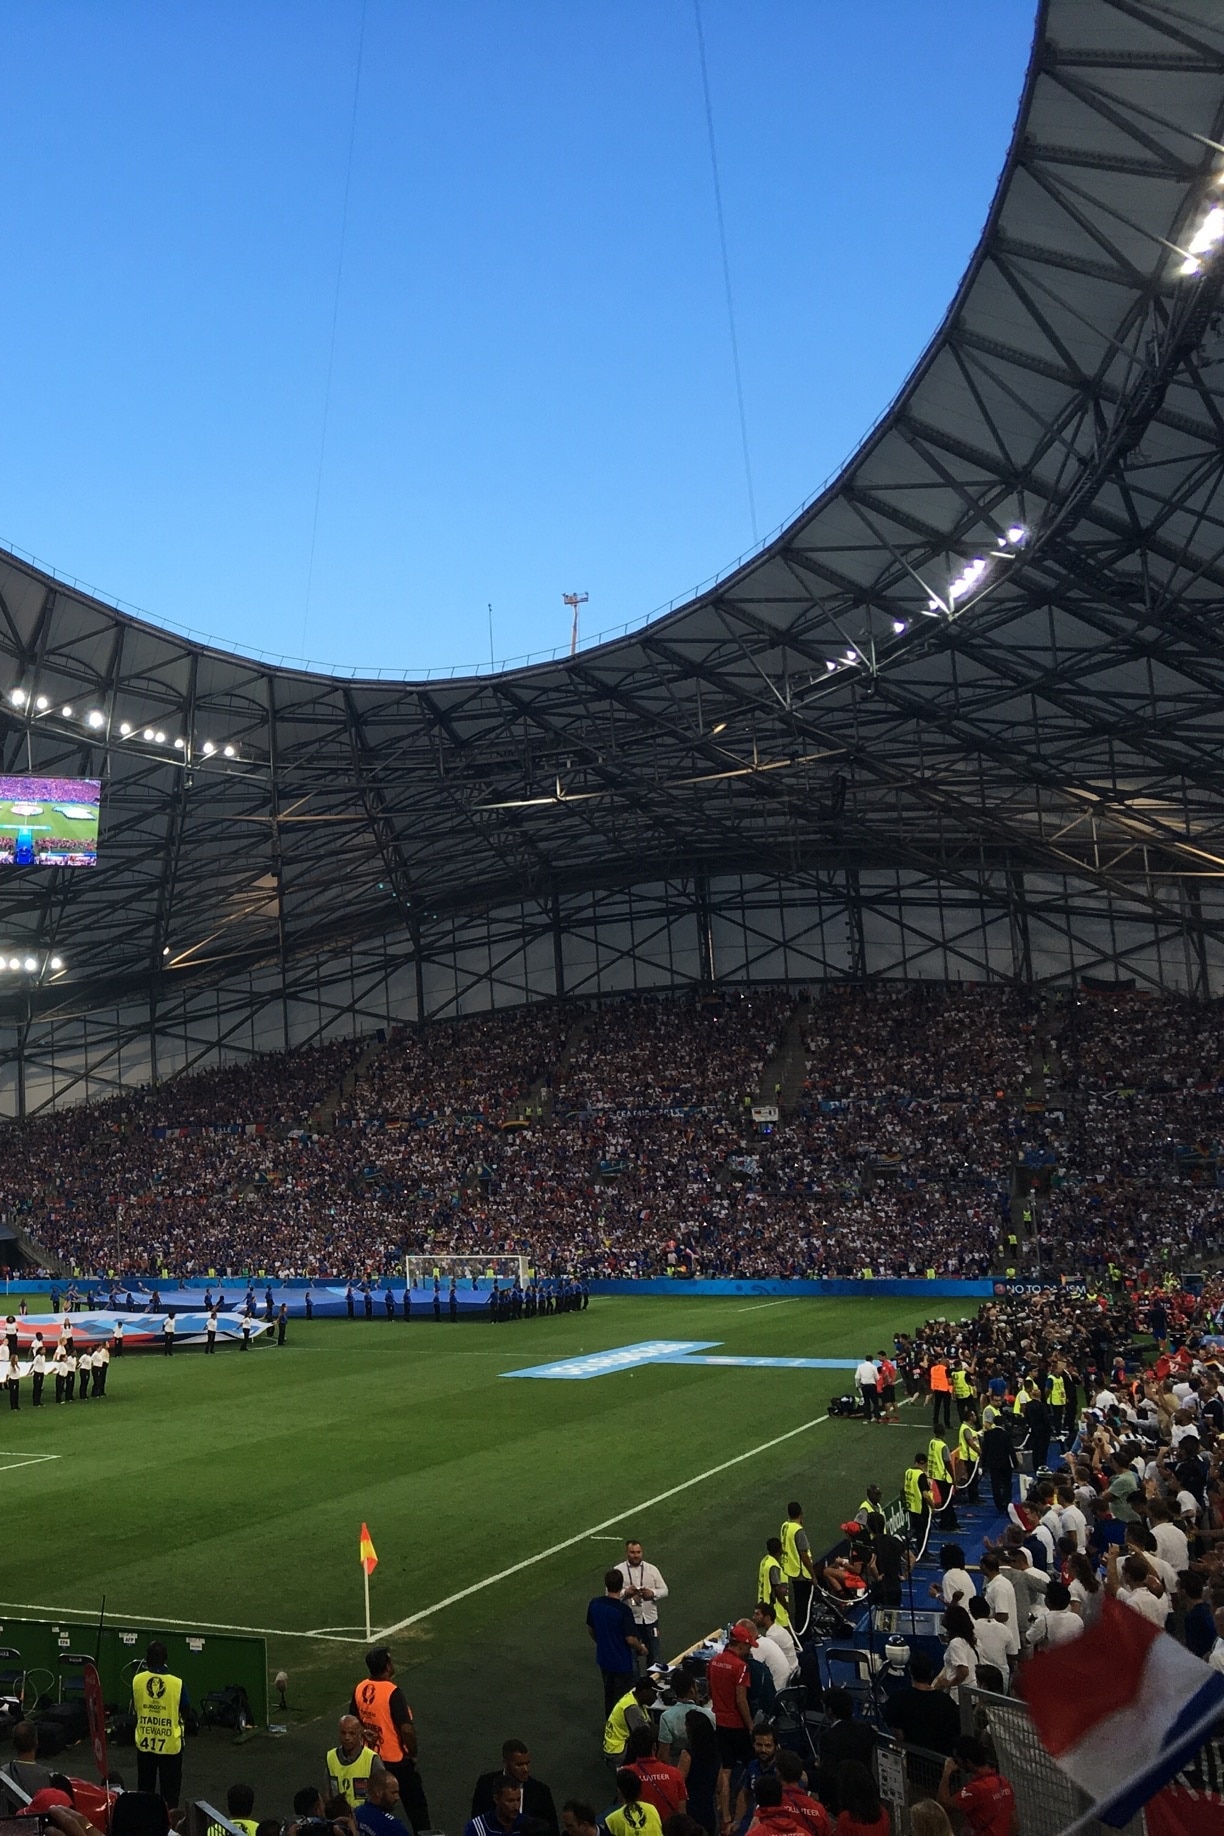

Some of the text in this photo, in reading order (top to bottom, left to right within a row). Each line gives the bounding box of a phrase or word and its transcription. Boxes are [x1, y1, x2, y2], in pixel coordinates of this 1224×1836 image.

[1006, 1284, 1025, 1295] NO
[1026, 1284, 1042, 1295] TO
[140, 1736, 166, 1752] 417
